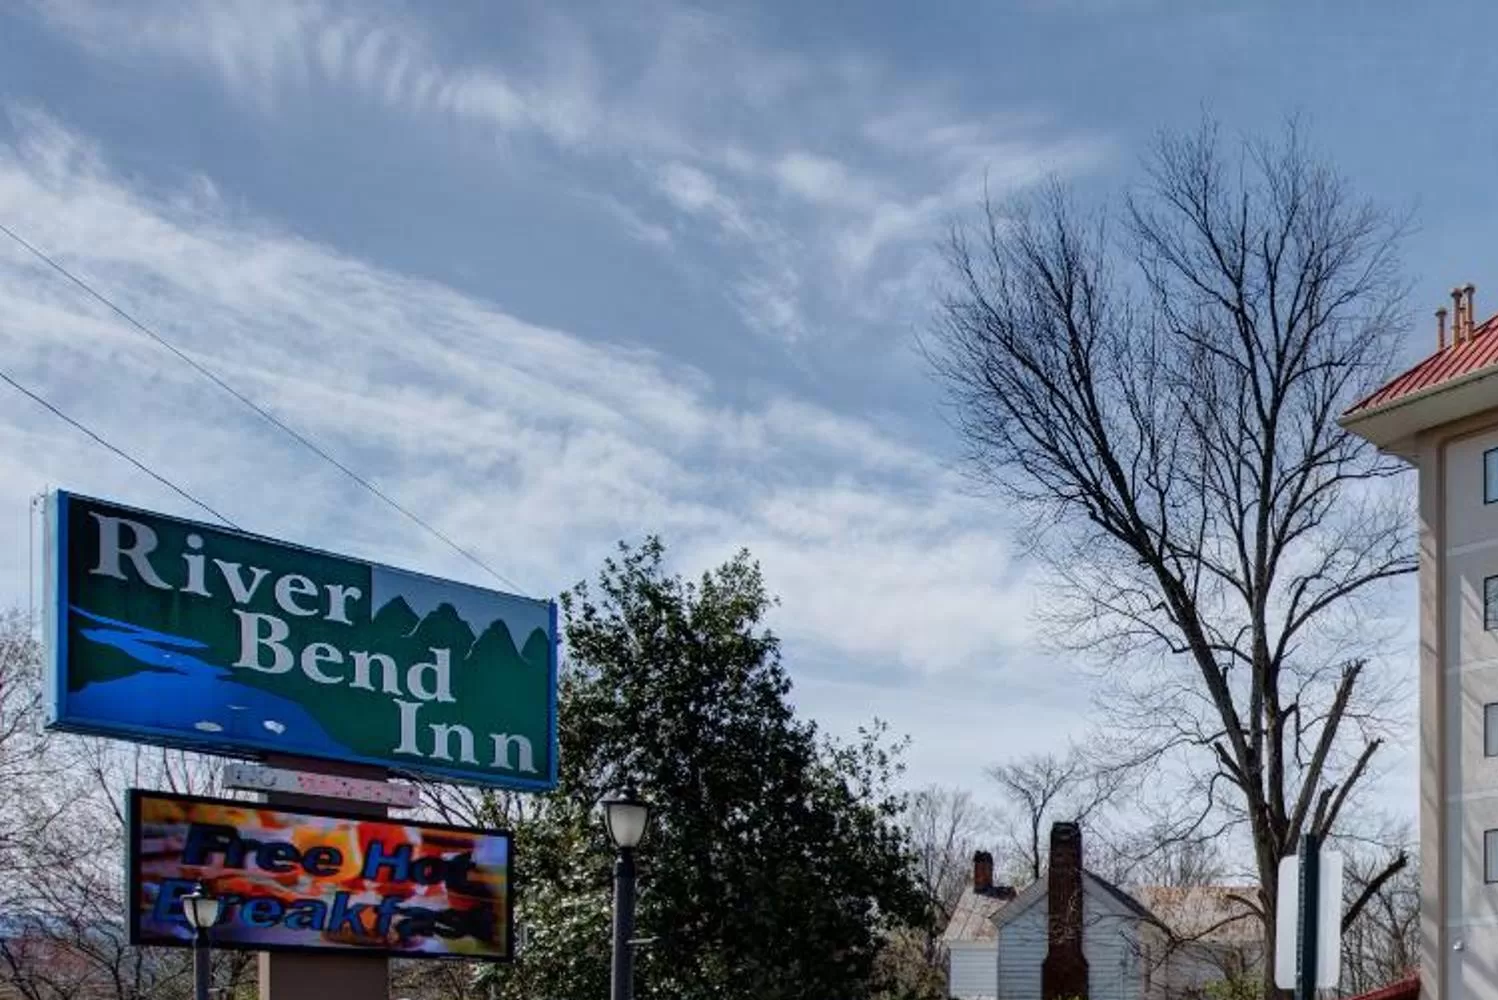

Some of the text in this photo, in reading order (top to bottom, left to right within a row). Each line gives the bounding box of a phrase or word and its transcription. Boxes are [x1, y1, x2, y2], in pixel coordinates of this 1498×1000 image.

[88, 510, 362, 625] River
[232, 608, 457, 703] Bend
[393, 698, 541, 774] Inn
[182, 823, 343, 877] Free
[153, 877, 493, 942] Breakf
